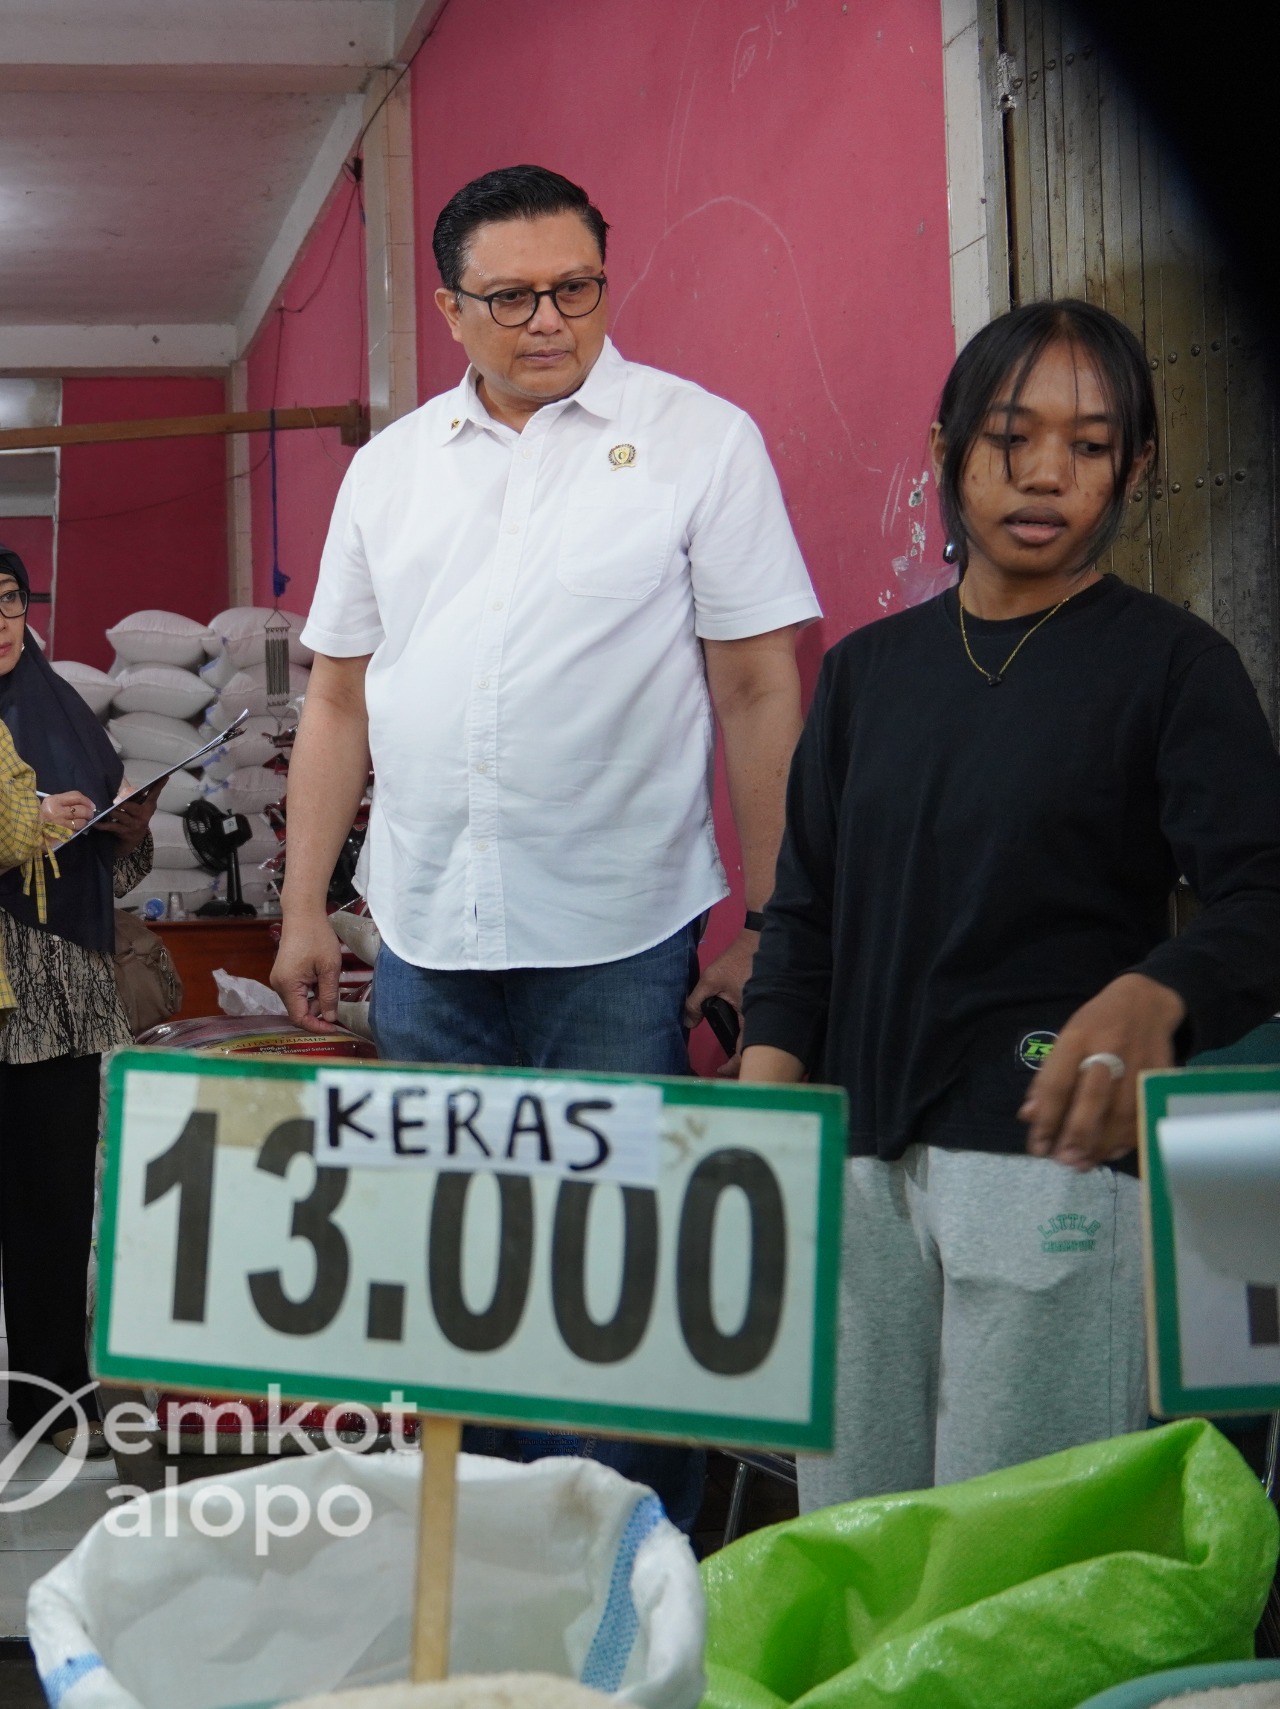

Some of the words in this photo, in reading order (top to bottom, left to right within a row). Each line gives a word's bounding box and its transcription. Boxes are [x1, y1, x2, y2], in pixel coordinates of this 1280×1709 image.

[325, 1085, 614, 1173] KERAS
[142, 1111, 788, 1378] 13.000
[1037, 1213, 1101, 1239] LITTLE
